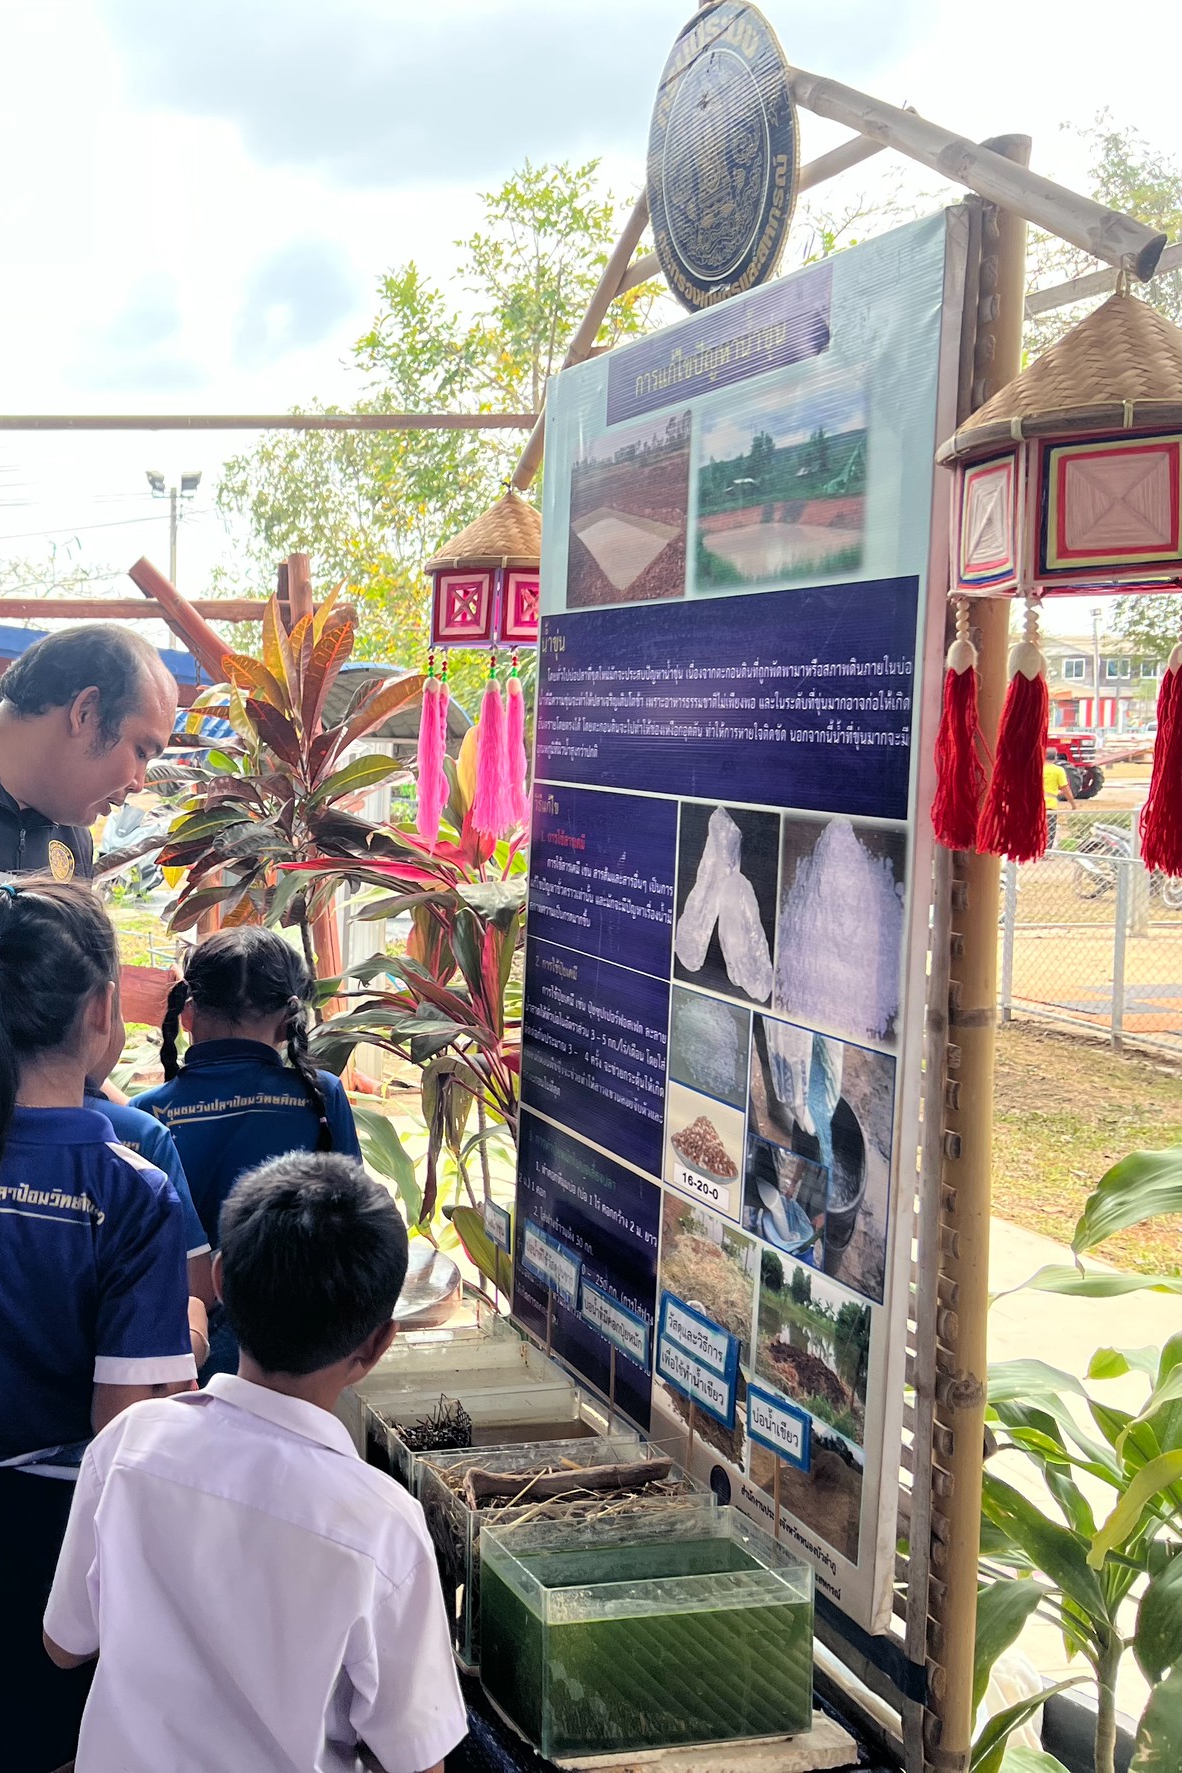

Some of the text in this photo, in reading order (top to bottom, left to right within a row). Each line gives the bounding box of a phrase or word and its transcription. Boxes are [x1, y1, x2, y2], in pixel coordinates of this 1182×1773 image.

[681, 1171, 720, 1202] 16-20-0
[668, 1312, 724, 1365] วัสดุและวิธีการ
[661, 1348, 725, 1408] เพื่อใช้ทำน้ำเขียว
[751, 1401, 800, 1450] บ่อน้ำเขียว
